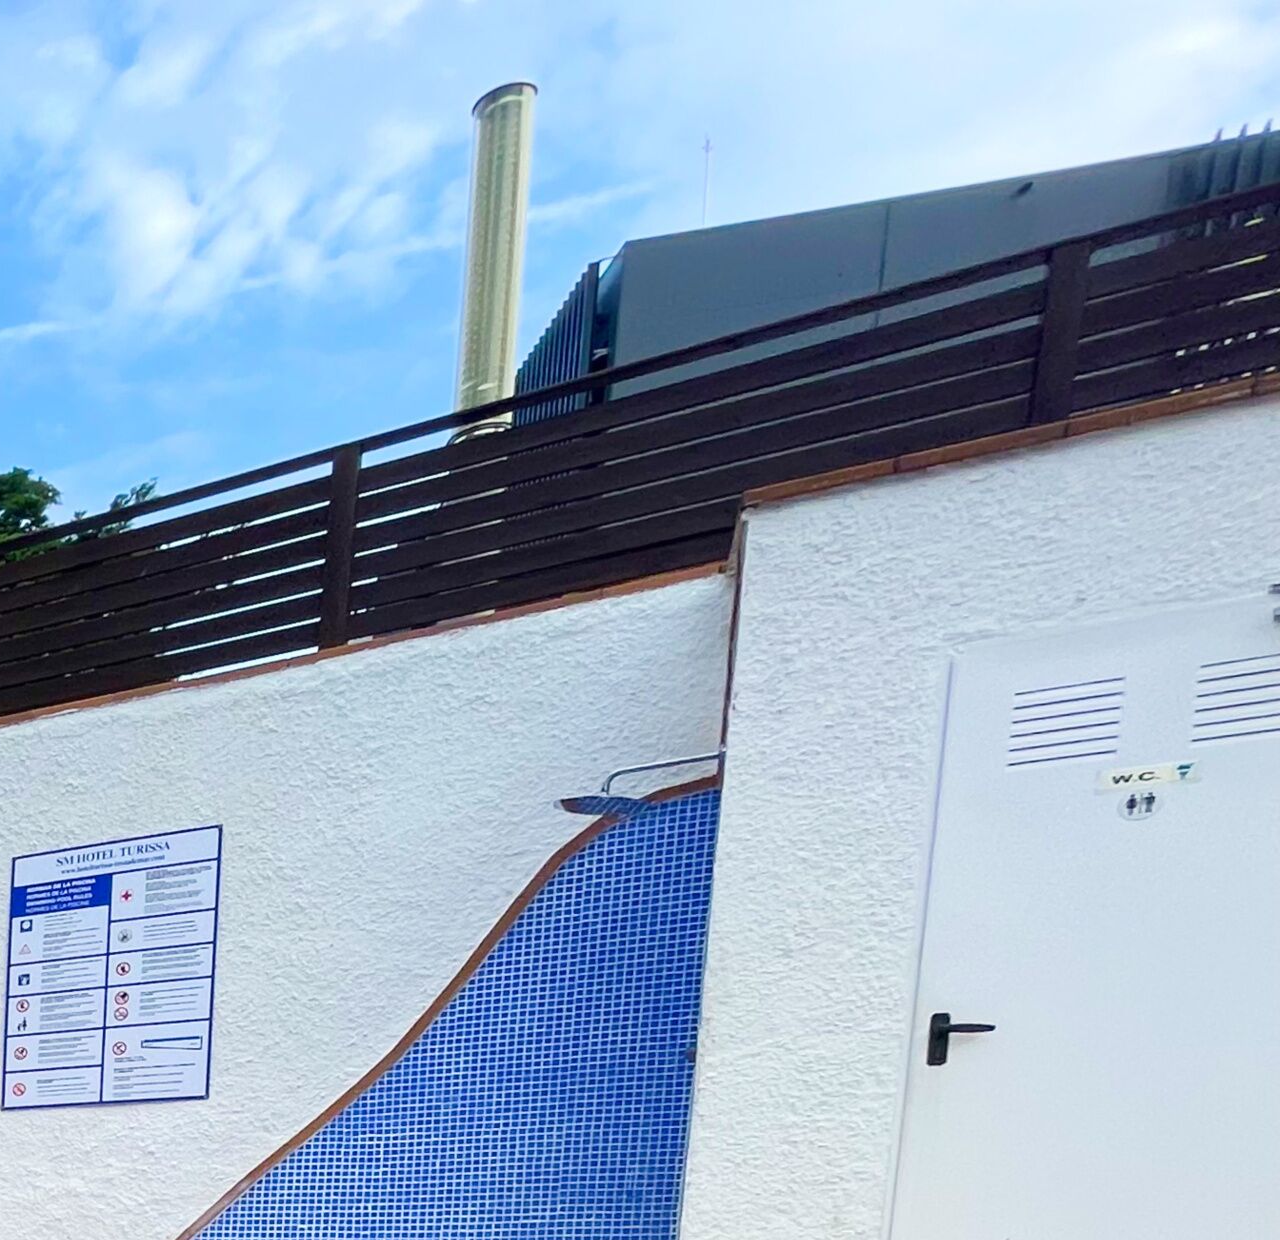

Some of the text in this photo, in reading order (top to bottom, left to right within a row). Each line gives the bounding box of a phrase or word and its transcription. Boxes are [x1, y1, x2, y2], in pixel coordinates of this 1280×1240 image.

[56, 855, 74, 867] SM
[77, 849, 115, 864] HOTEL
[120, 841, 170, 857] TURISSA
